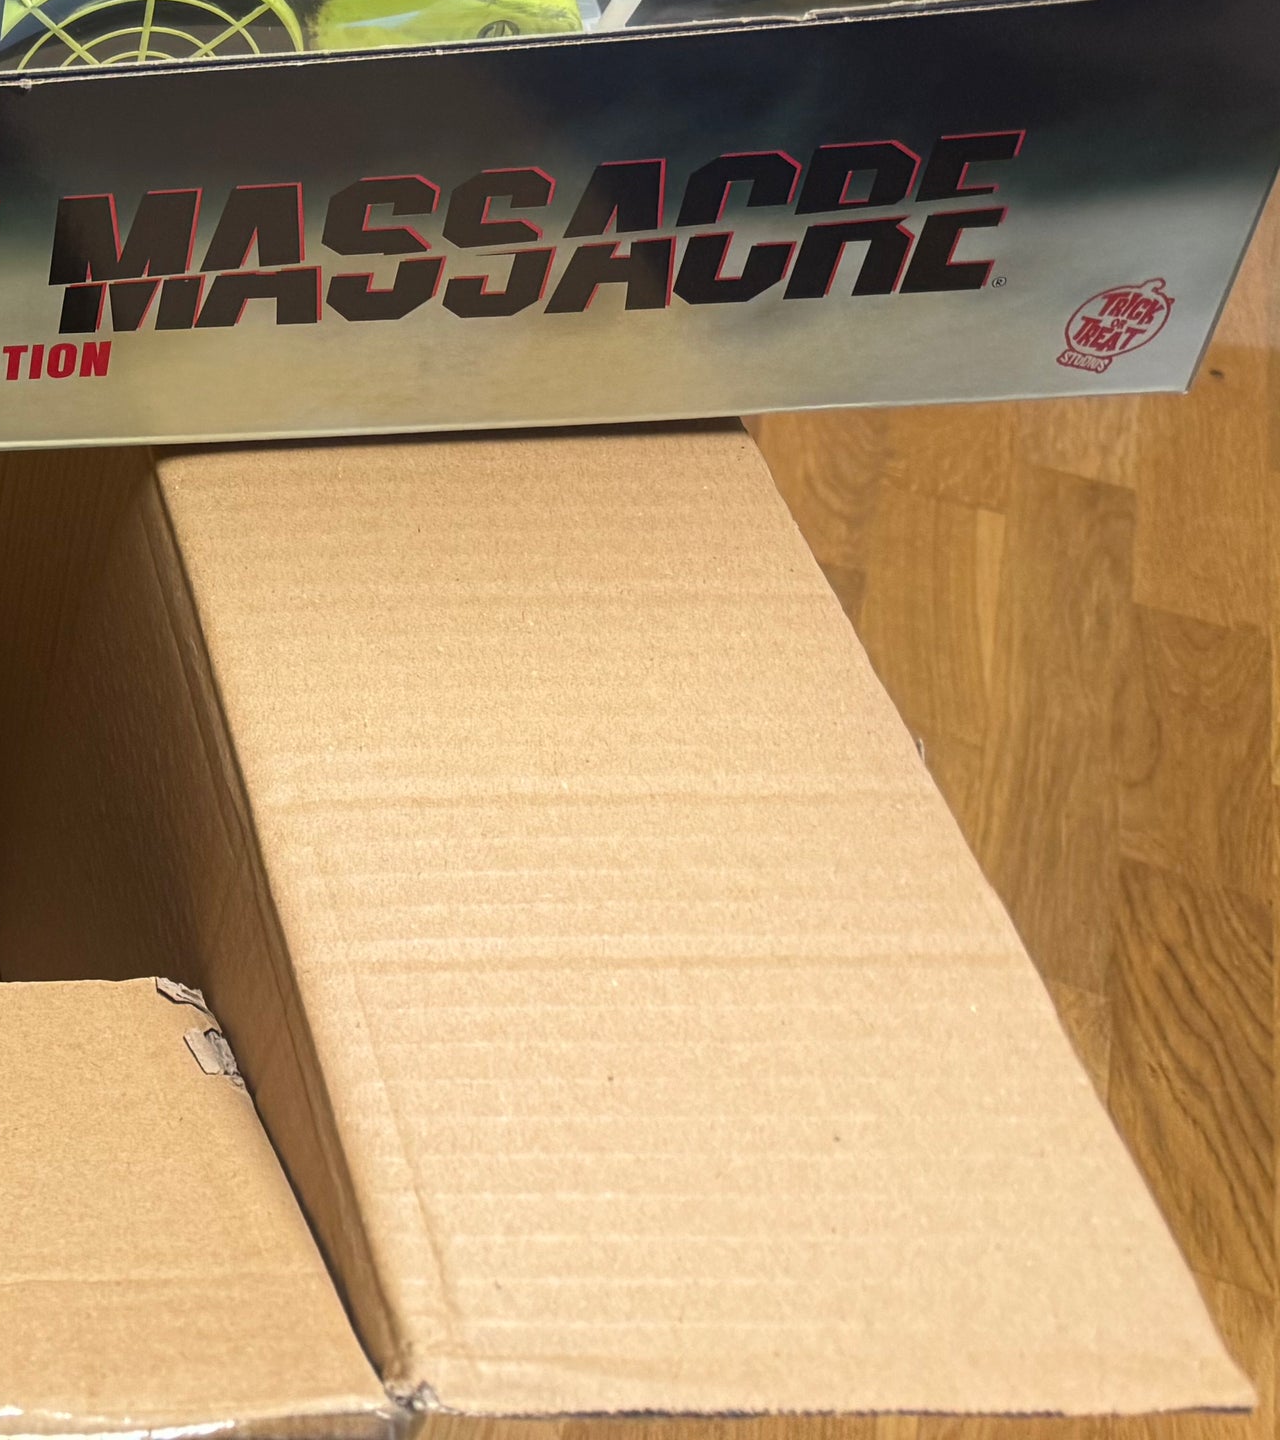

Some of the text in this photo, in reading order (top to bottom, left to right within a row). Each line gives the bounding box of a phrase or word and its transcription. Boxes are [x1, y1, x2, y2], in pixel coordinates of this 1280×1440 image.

[48, 129, 1026, 334] MASSACRE
[1098, 290, 1165, 326] TRICK
[1072, 316, 1147, 352] TREAT
[1060, 351, 1108, 372] STUDIOS
